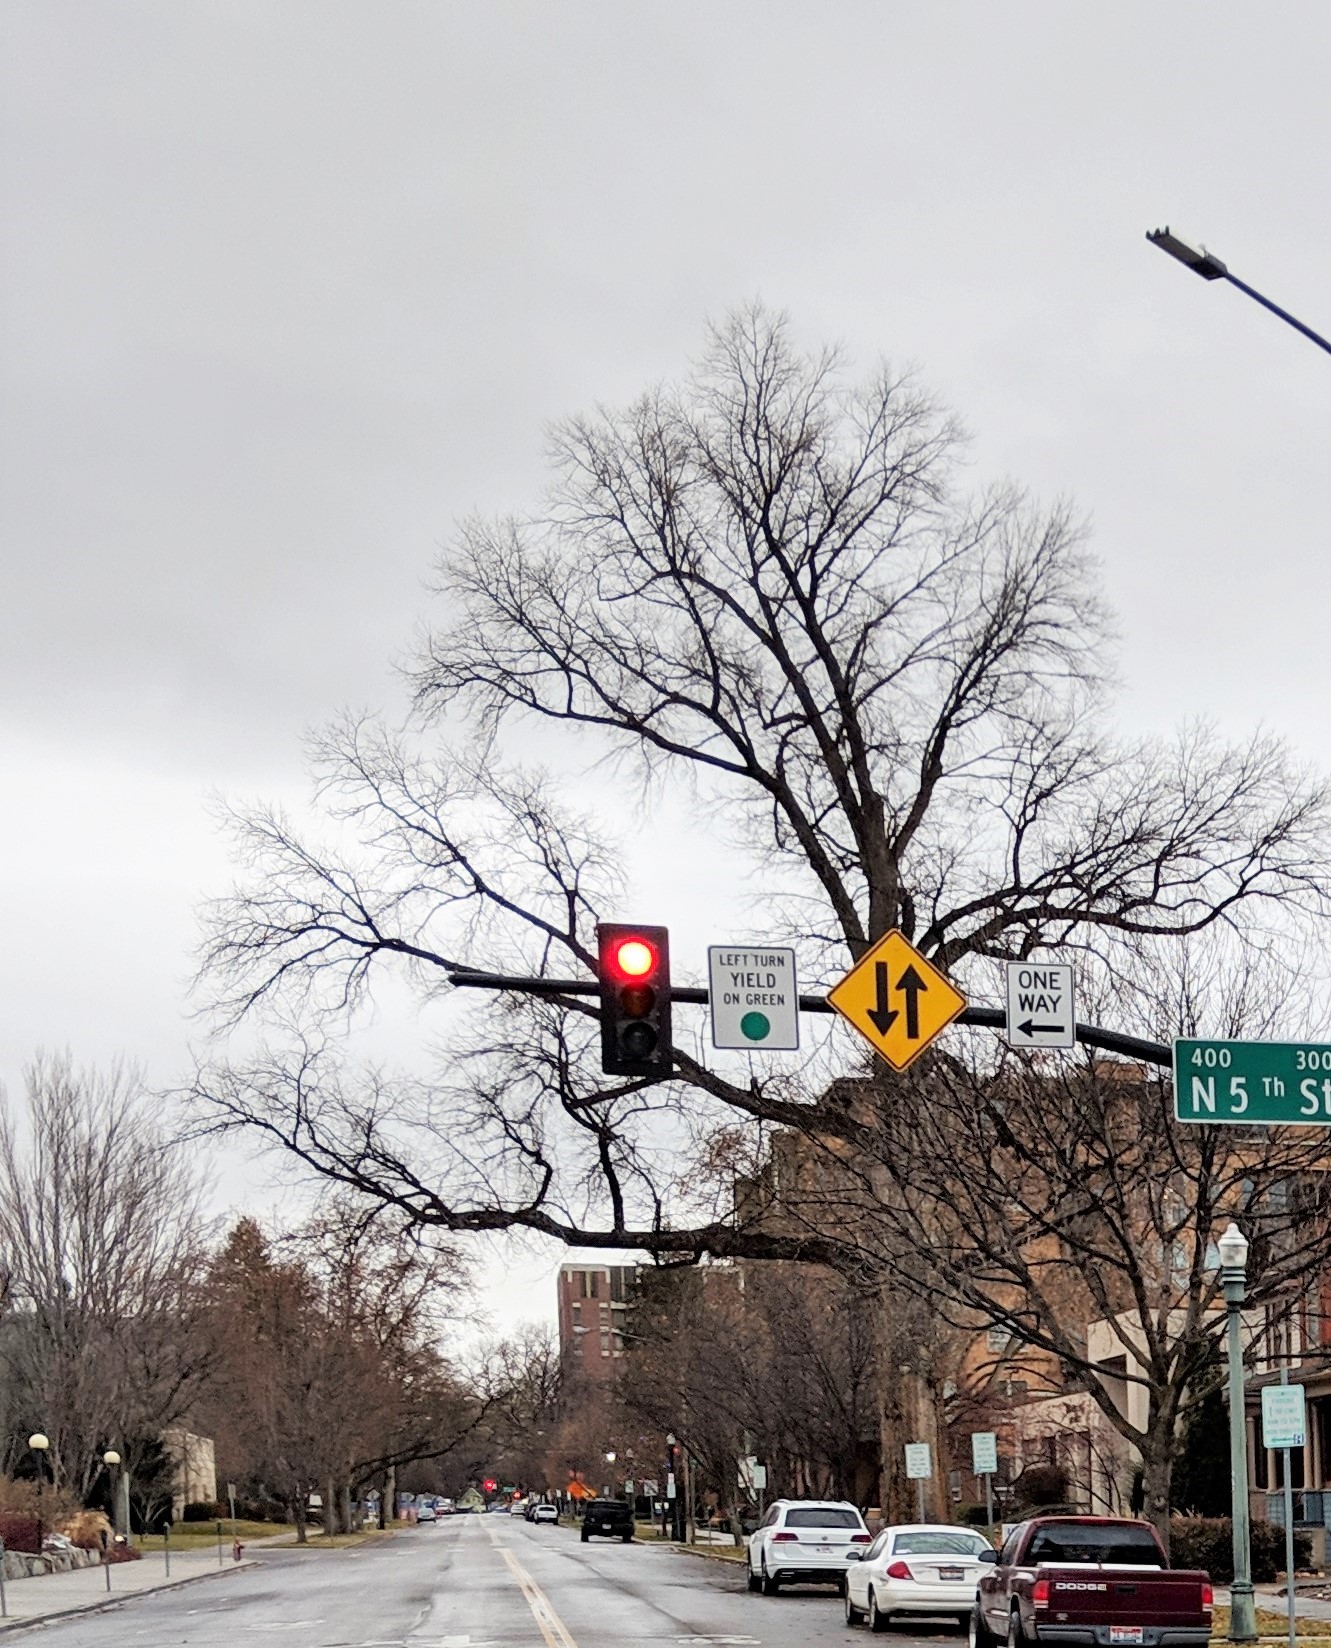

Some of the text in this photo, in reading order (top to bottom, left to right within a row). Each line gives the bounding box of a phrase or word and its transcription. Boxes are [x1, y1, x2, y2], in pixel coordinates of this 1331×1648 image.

[719, 954, 785, 967] LEFT TURN
[730, 972, 776, 988] YIELD
[1018, 970, 1062, 990] ONE
[723, 993, 785, 1005] ON GREEN
[1018, 993, 1062, 1013] WAY
[1191, 1048, 1232, 1068] 400
[1191, 1076, 1216, 1113] N
[1230, 1076, 1249, 1114] 5
[1262, 1076, 1285, 1098] Th
